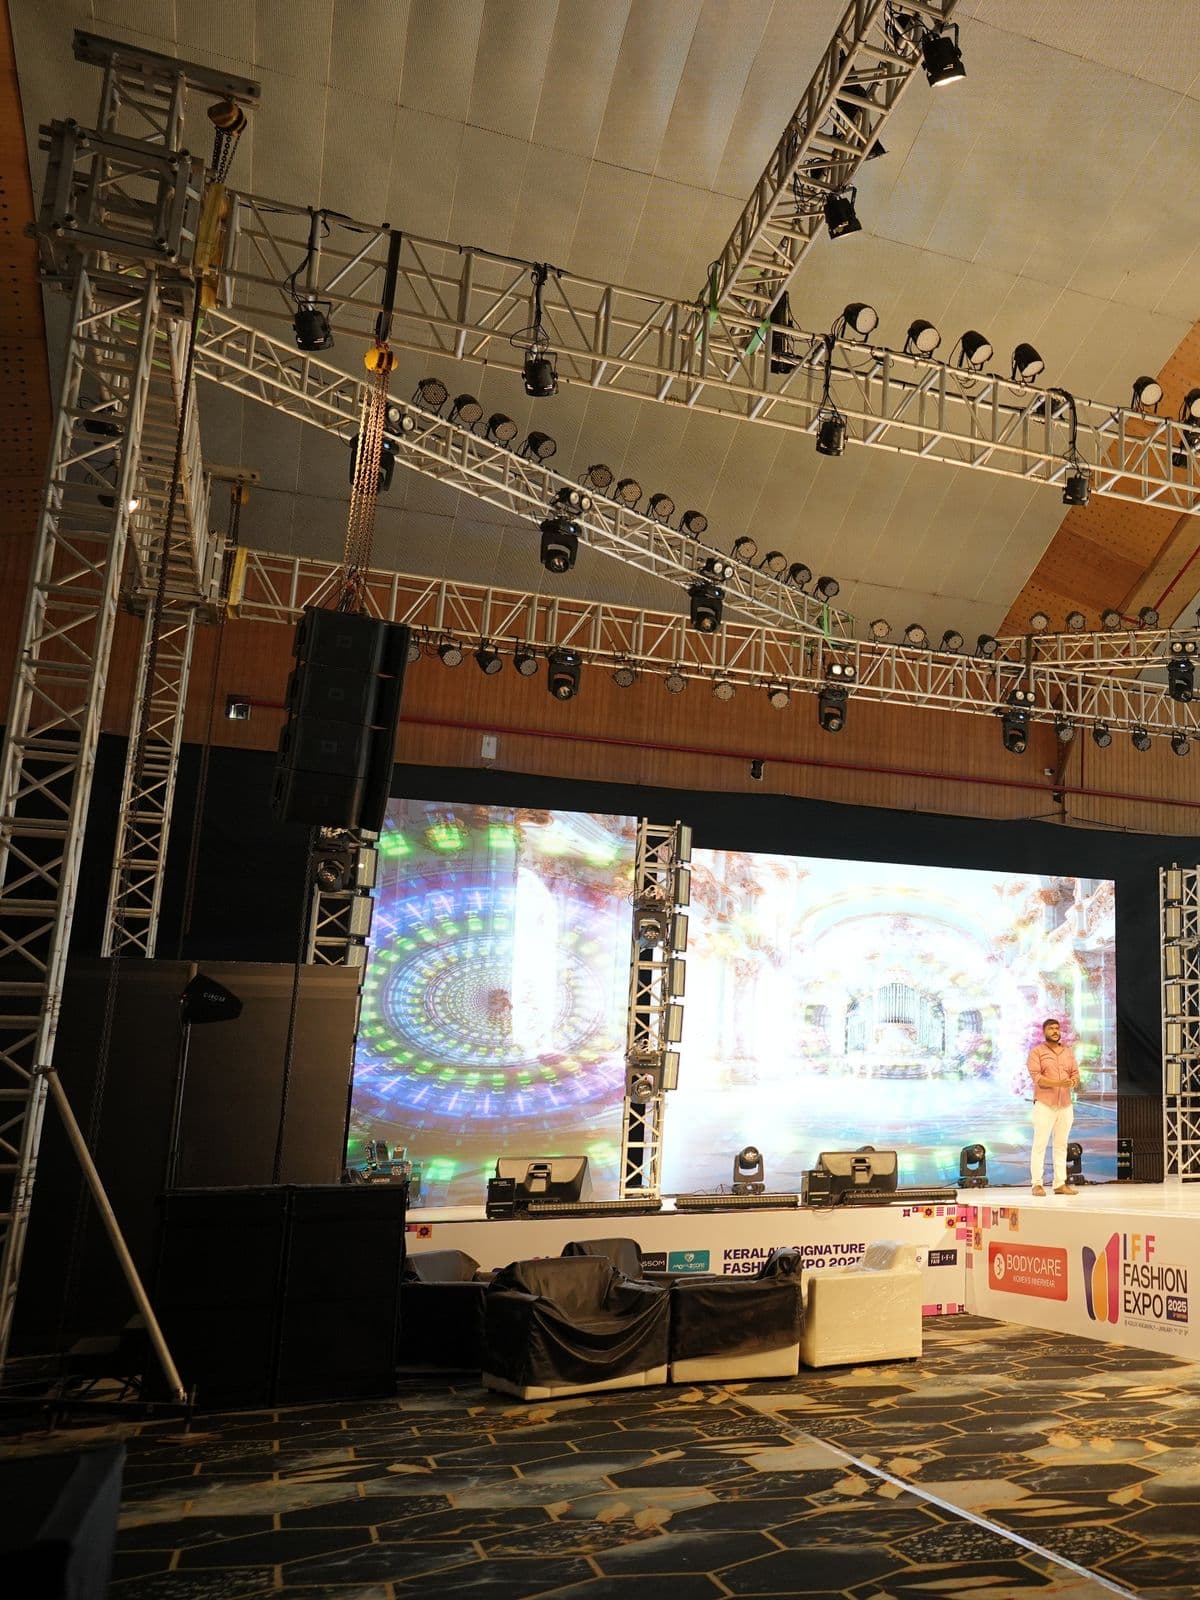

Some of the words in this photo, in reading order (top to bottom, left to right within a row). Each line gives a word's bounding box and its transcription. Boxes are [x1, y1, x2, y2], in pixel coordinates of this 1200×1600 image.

[1006, 1254, 1062, 1277] BODYCARE
[1123, 1263, 1188, 1294] FASHION
[1123, 1290, 1164, 1319] EXPO
[1167, 1299, 1187, 1313] 2025
